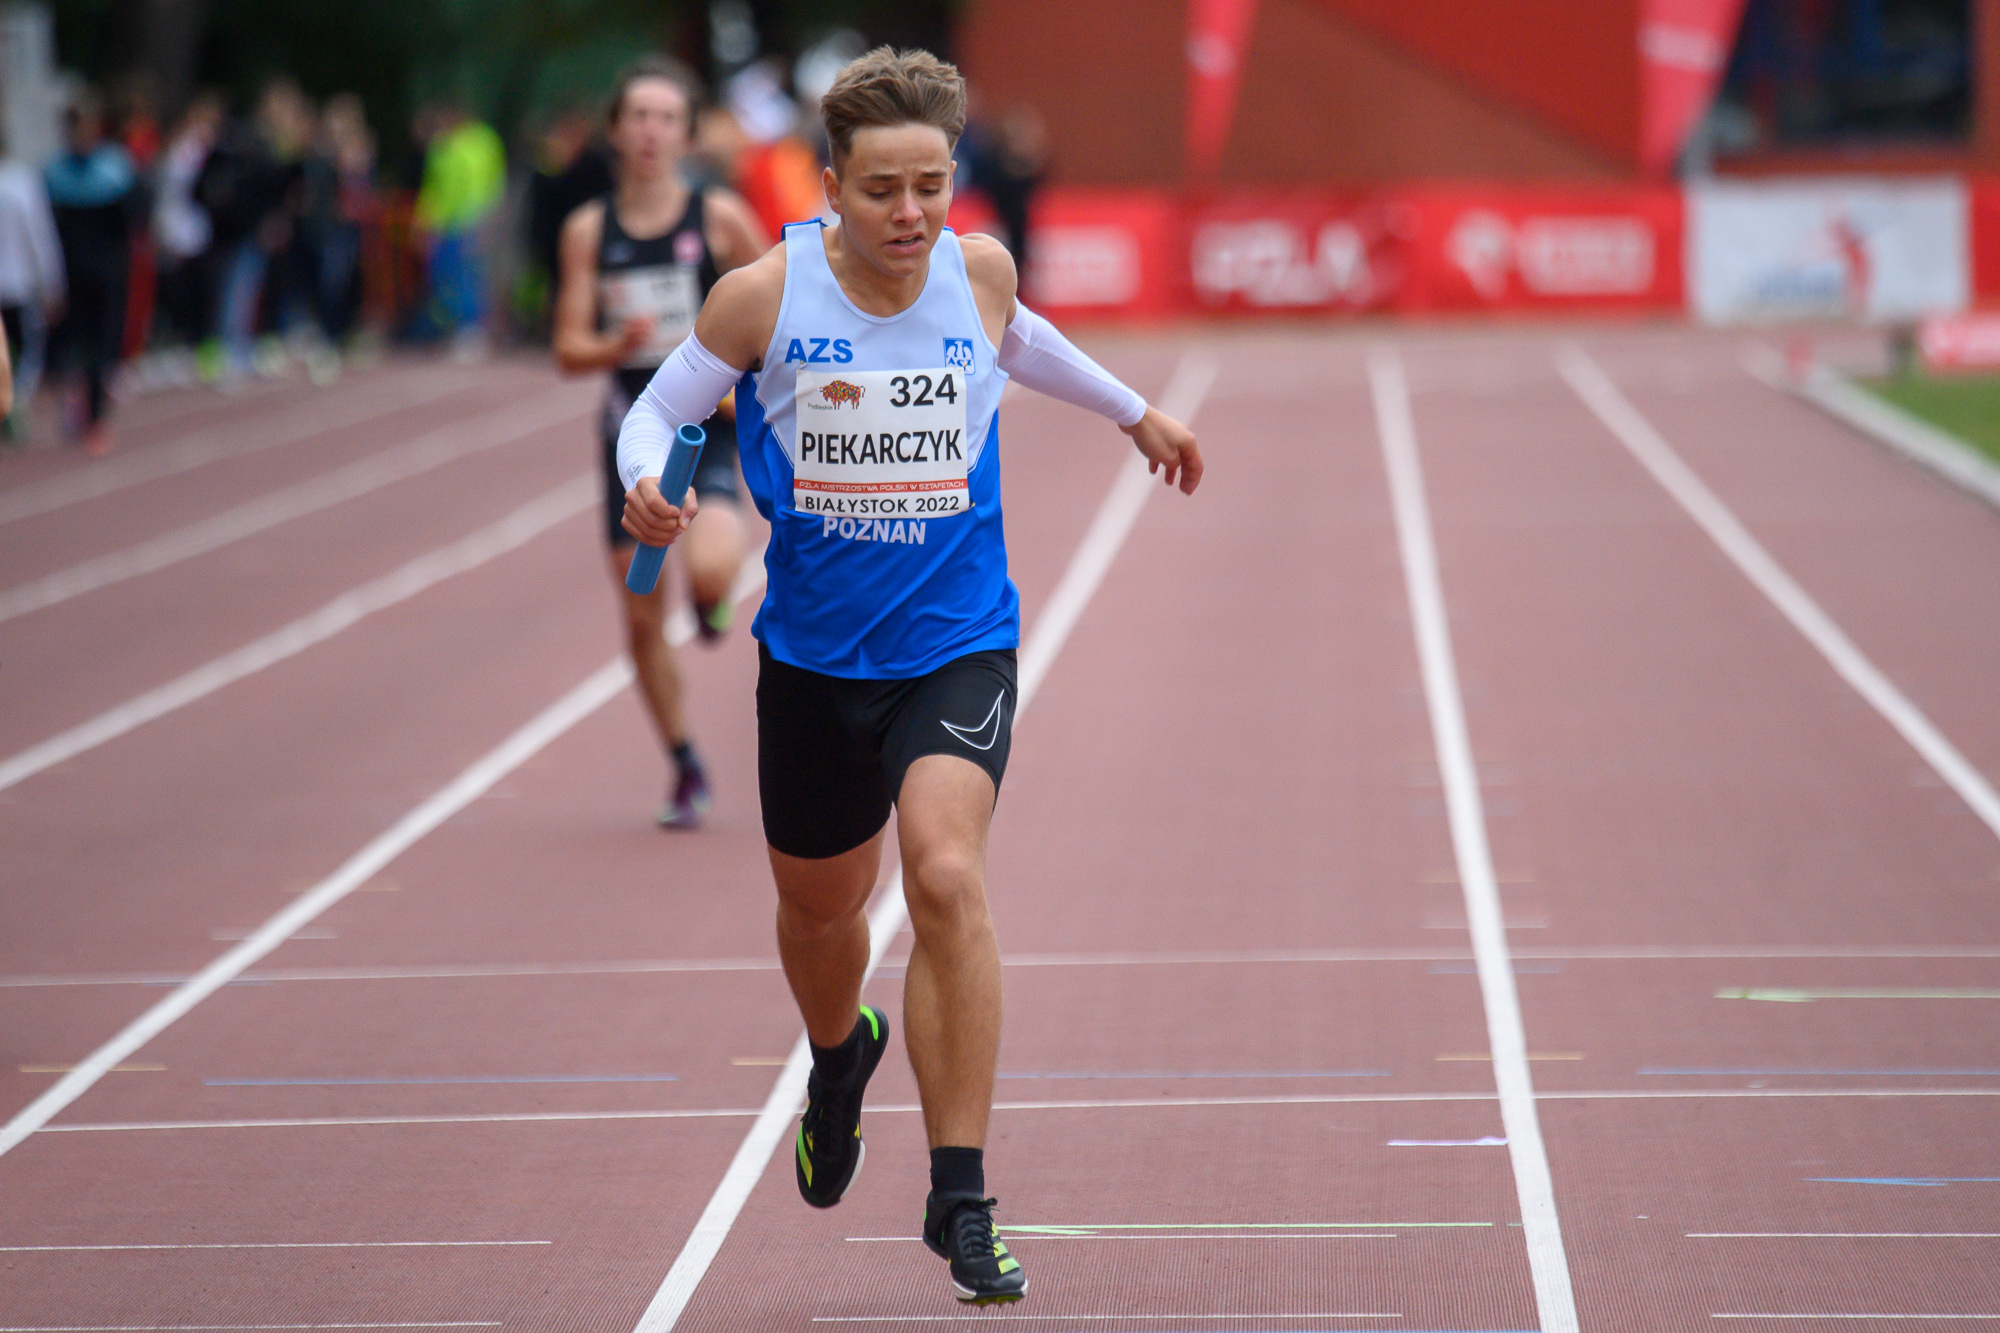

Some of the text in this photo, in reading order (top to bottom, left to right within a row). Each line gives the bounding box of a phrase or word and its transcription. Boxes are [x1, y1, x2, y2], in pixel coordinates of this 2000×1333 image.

[784, 338, 853, 364] AZS
[890, 373, 957, 408] 324
[802, 429, 962, 465] PIEKARCZYK
[799, 481, 819, 490] PZLA
[821, 484, 878, 492] MISTRZOSTWA
[919, 481, 964, 490] SZTAFETACH
[805, 496, 960, 513] BIAŁYSTOK 2022
